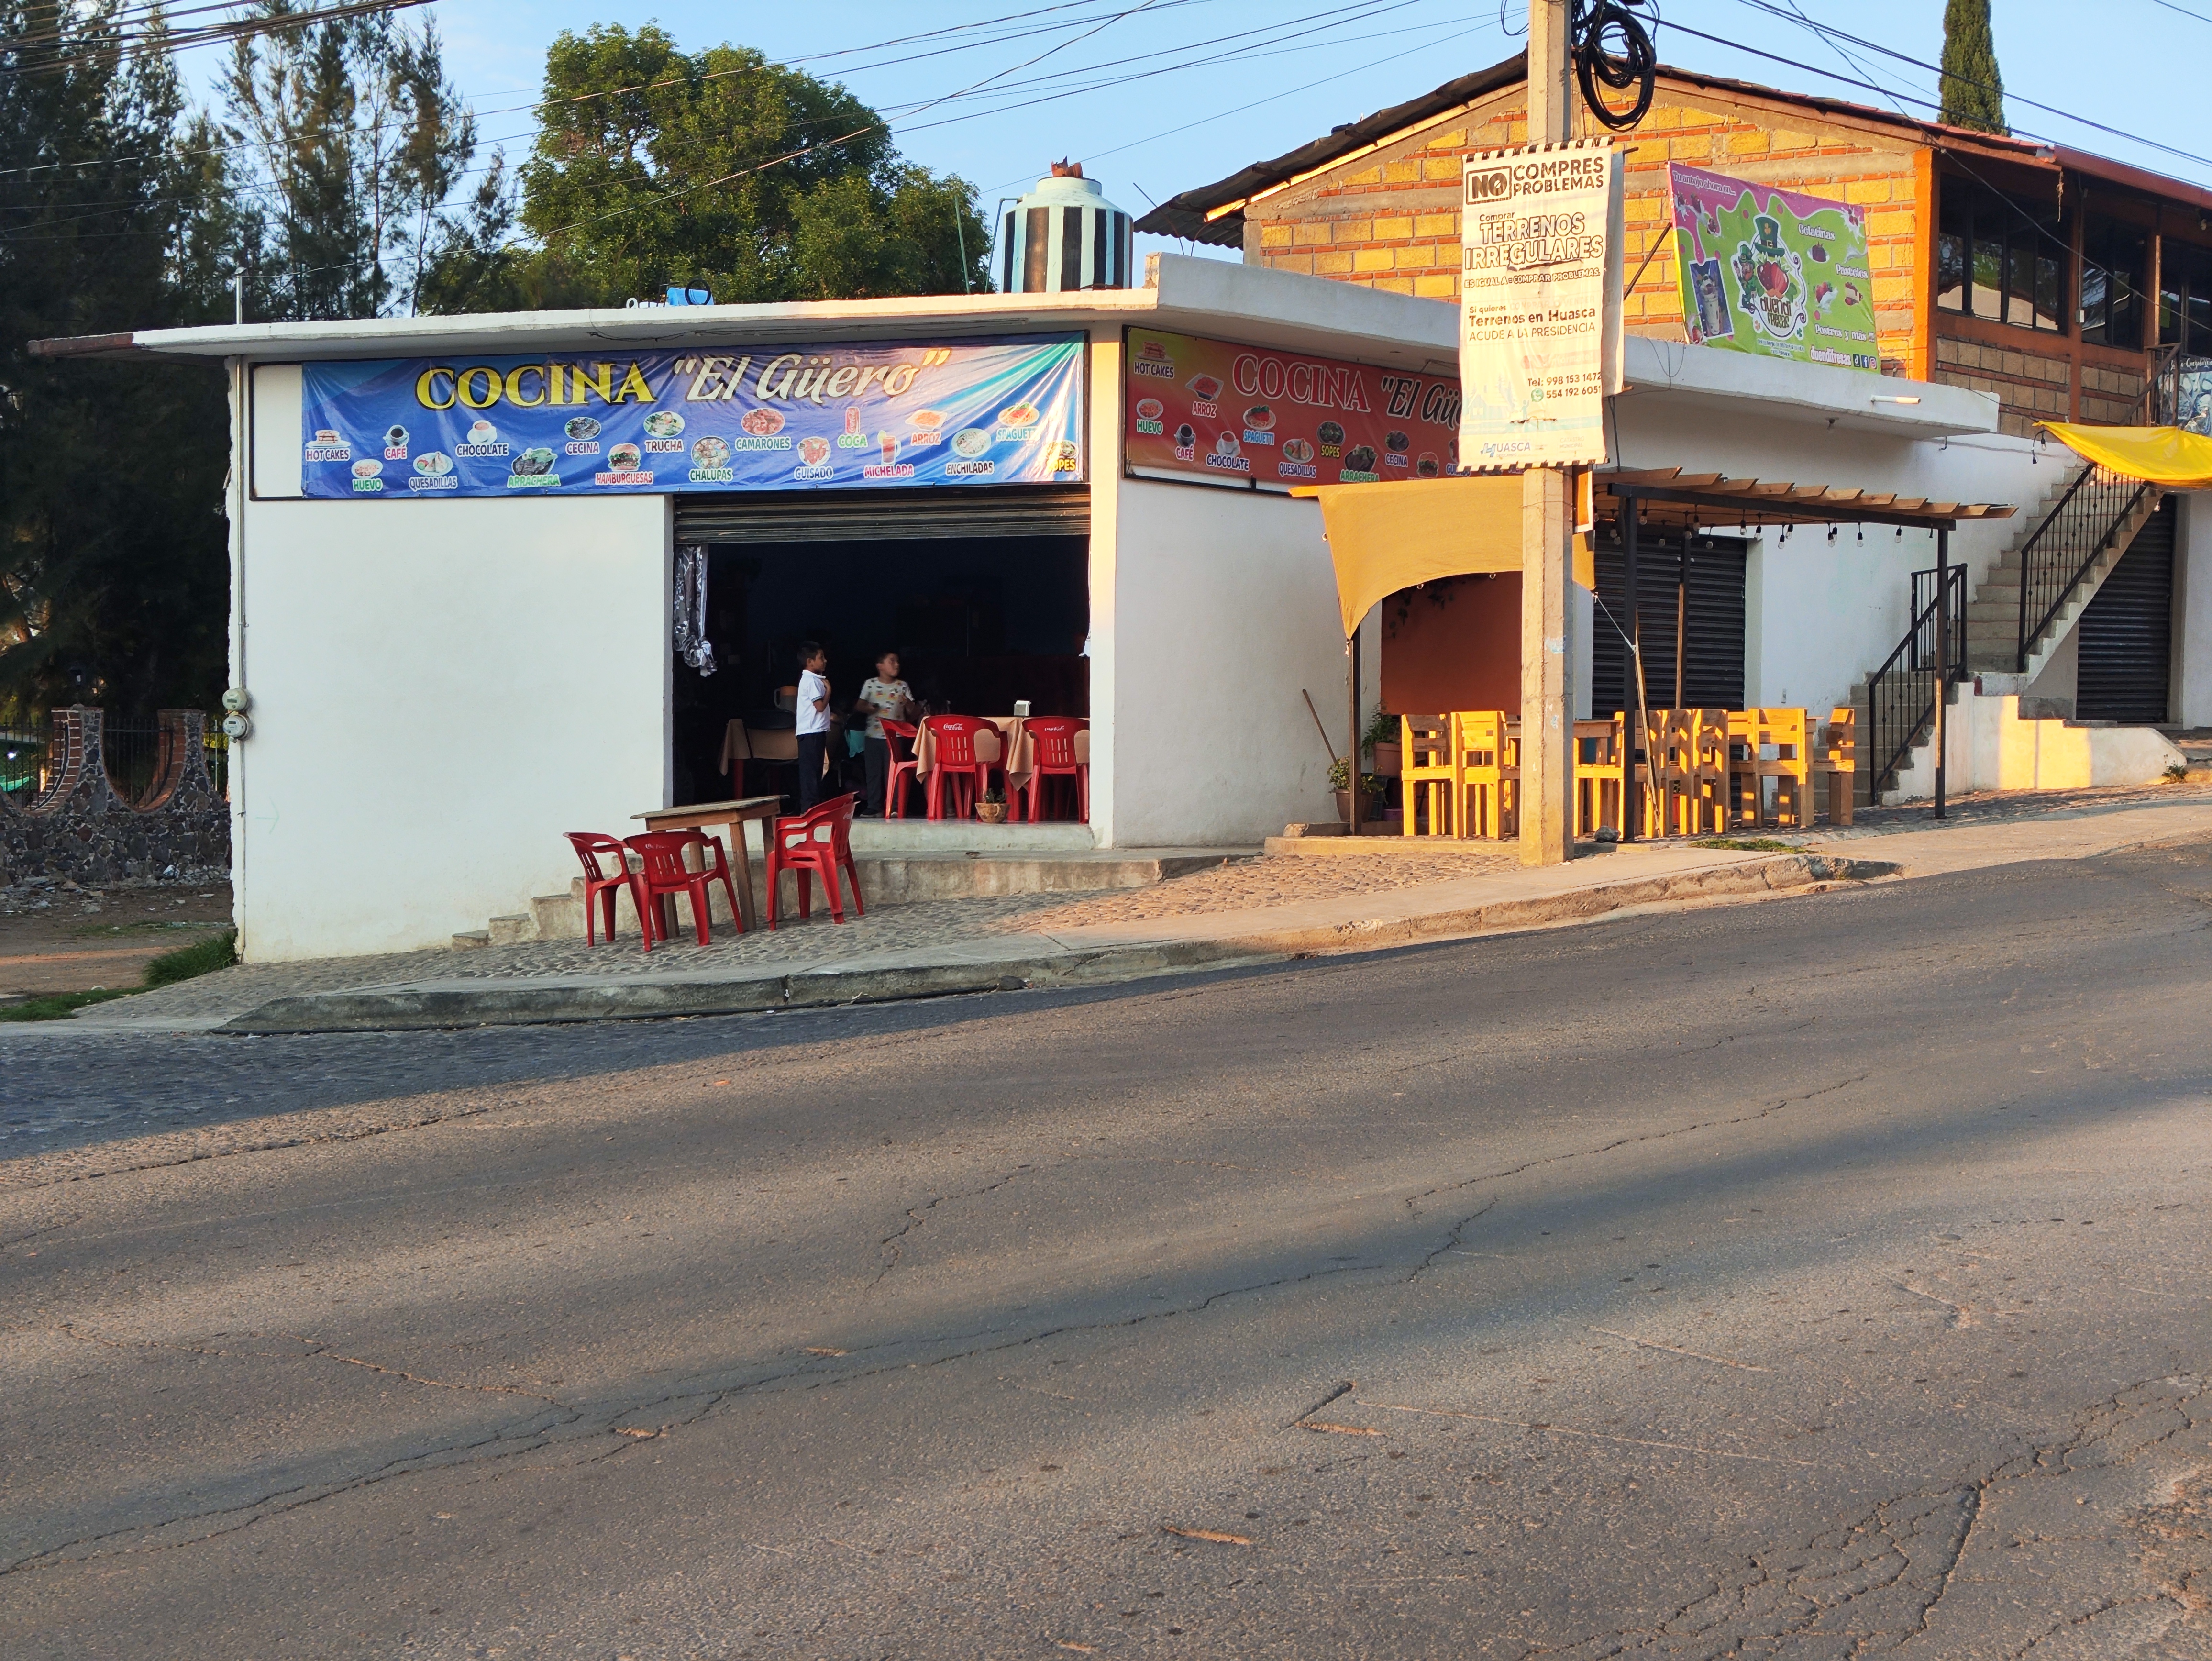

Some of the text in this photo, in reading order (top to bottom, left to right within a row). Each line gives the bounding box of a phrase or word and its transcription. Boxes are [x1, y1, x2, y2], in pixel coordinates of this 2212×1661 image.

[1513, 157, 1604, 181] COMPRES
[1472, 173, 1507, 199] NO
[1513, 175, 1604, 196] PROBLEMAS
[1673, 171, 1681, 182] Tu
[1682, 174, 1703, 189] antojo
[1703, 178, 1722, 192] ahora
[1480, 212, 1515, 223] Comprar
[1480, 212, 1585, 244] TERRENOS
[1798, 223, 1835, 241] Gelatinas
[1465, 235, 1604, 270] IRREGULARES
[1464, 279, 1475, 288] ES
[1476, 277, 1500, 287] IGUAL
[1501, 276, 1508, 285] A
[1513, 273, 1551, 284] COMPRAR
[1551, 268, 1601, 281] PROBLEMAS.
[1836, 264, 1869, 279] Pasteles
[1479, 305, 1506, 318] quieres
[1760, 296, 1792, 316] duendi
[1469, 308, 1595, 328] Terrenos en Huasca
[1469, 322, 1595, 342] ACUDE A LA PRESIDENCIA
[1815, 323, 1842, 338] Postres
[1844, 330, 1849, 342] y
[1851, 330, 1867, 341] más
[1810, 344, 1851, 366] duendifresas
[1134, 362, 1174, 378] HOT CAKES
[415, 361, 657, 410] COCINA
[1233, 354, 1371, 412] COCINA
[1527, 372, 1601, 387] Tel: 998 153 1472
[1546, 385, 1601, 399] 554 192 6051
[1192, 402, 1217, 418] ARROZ
[1137, 420, 1162, 434] HUEVO
[736, 438, 791, 450] CAMARONES
[839, 435, 867, 447] COCA
[911, 432, 941, 445] ARROZ
[1243, 430, 1274, 445] SPAGUETTI
[385, 445, 406, 459] CAFÉ
[456, 444, 509, 456] CHOCOLATE
[566, 442, 600, 454] CECINA
[645, 440, 683, 452] TRUCHA
[1175, 445, 1194, 461] CAFÉ
[1321, 445, 1340, 458] SOPES
[306, 449, 349, 460] HOT CAKES
[1385, 454, 1408, 467] CECINA
[947, 462, 994, 475] ENCHILADAS
[1206, 454, 1250, 471] CHOCOLATE
[690, 469, 732, 481] CHALUPAS
[795, 466, 833, 479] GUISADO
[864, 465, 914, 478] MICHELADA
[1279, 463, 1316, 478] QUESADILLAS
[1340, 470, 1380, 482] ARRACHERA
[353, 479, 382, 491] HUEVO
[409, 477, 457, 490] QUESADILLAS
[508, 475, 560, 487] ARRACHERA
[596, 472, 653, 484] HAMBURGUESAS
